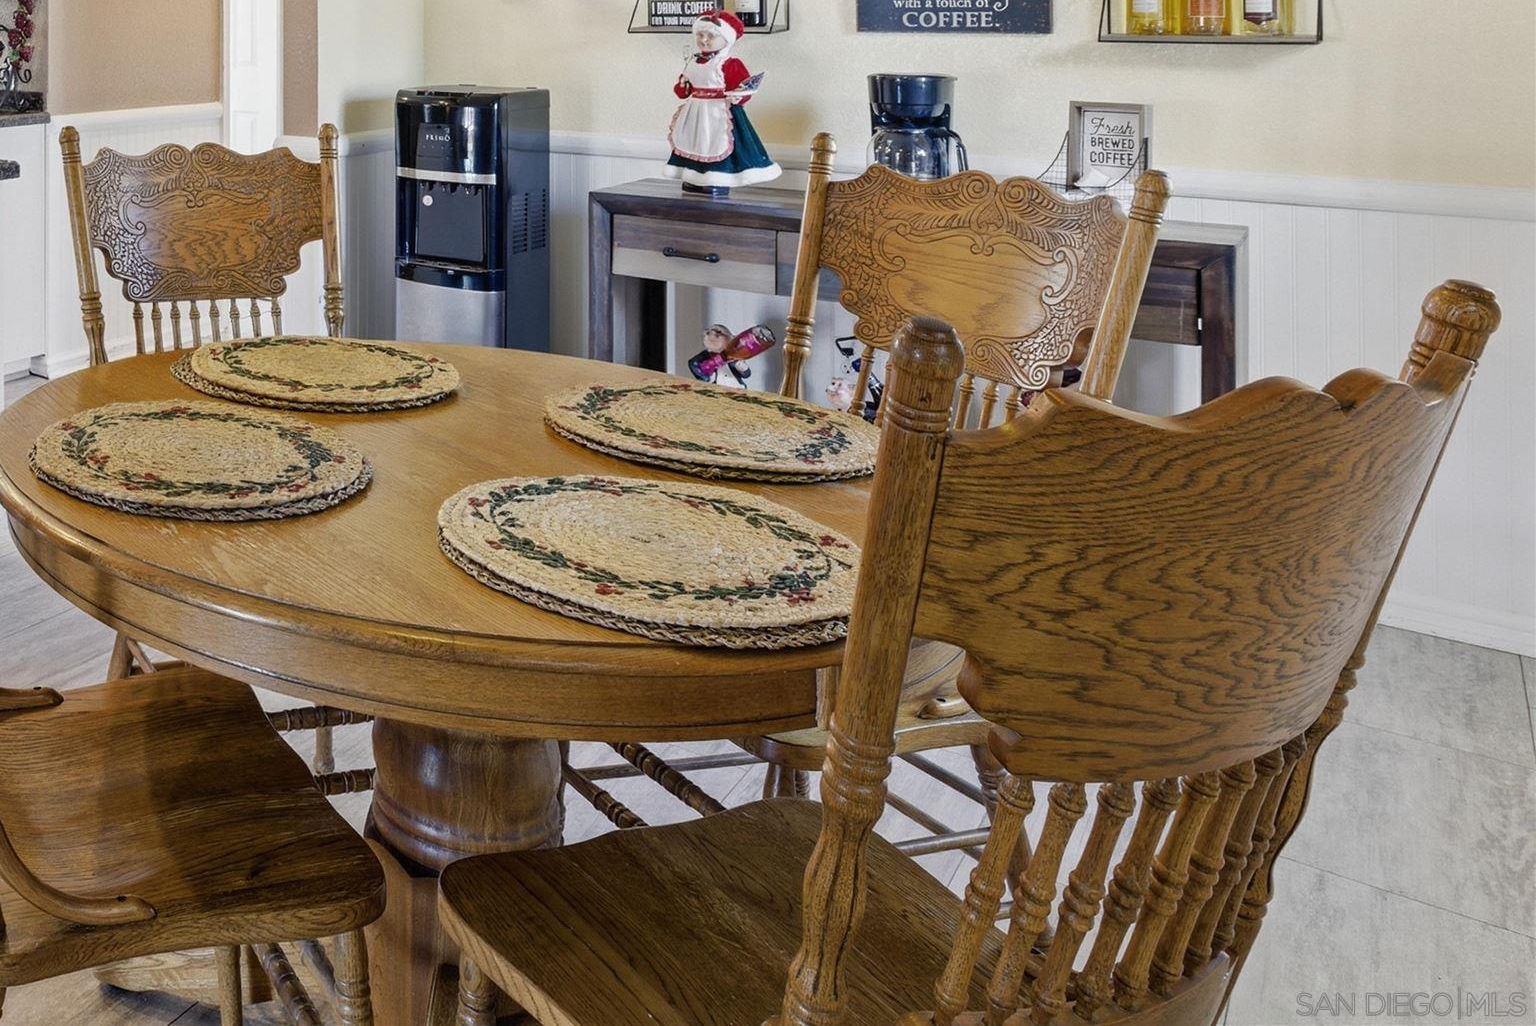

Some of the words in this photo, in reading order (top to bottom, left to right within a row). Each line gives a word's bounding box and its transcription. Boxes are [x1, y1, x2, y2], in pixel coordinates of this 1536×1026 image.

[651, 1, 655, 14] I
[657, 1, 682, 14] DRINK
[925, 0, 933, 8] a
[902, 10, 1001, 28] COFFEE.
[1090, 117, 1136, 135] Fresh
[1090, 136, 1135, 152] BREWED
[1089, 151, 1134, 166] COFFEE
